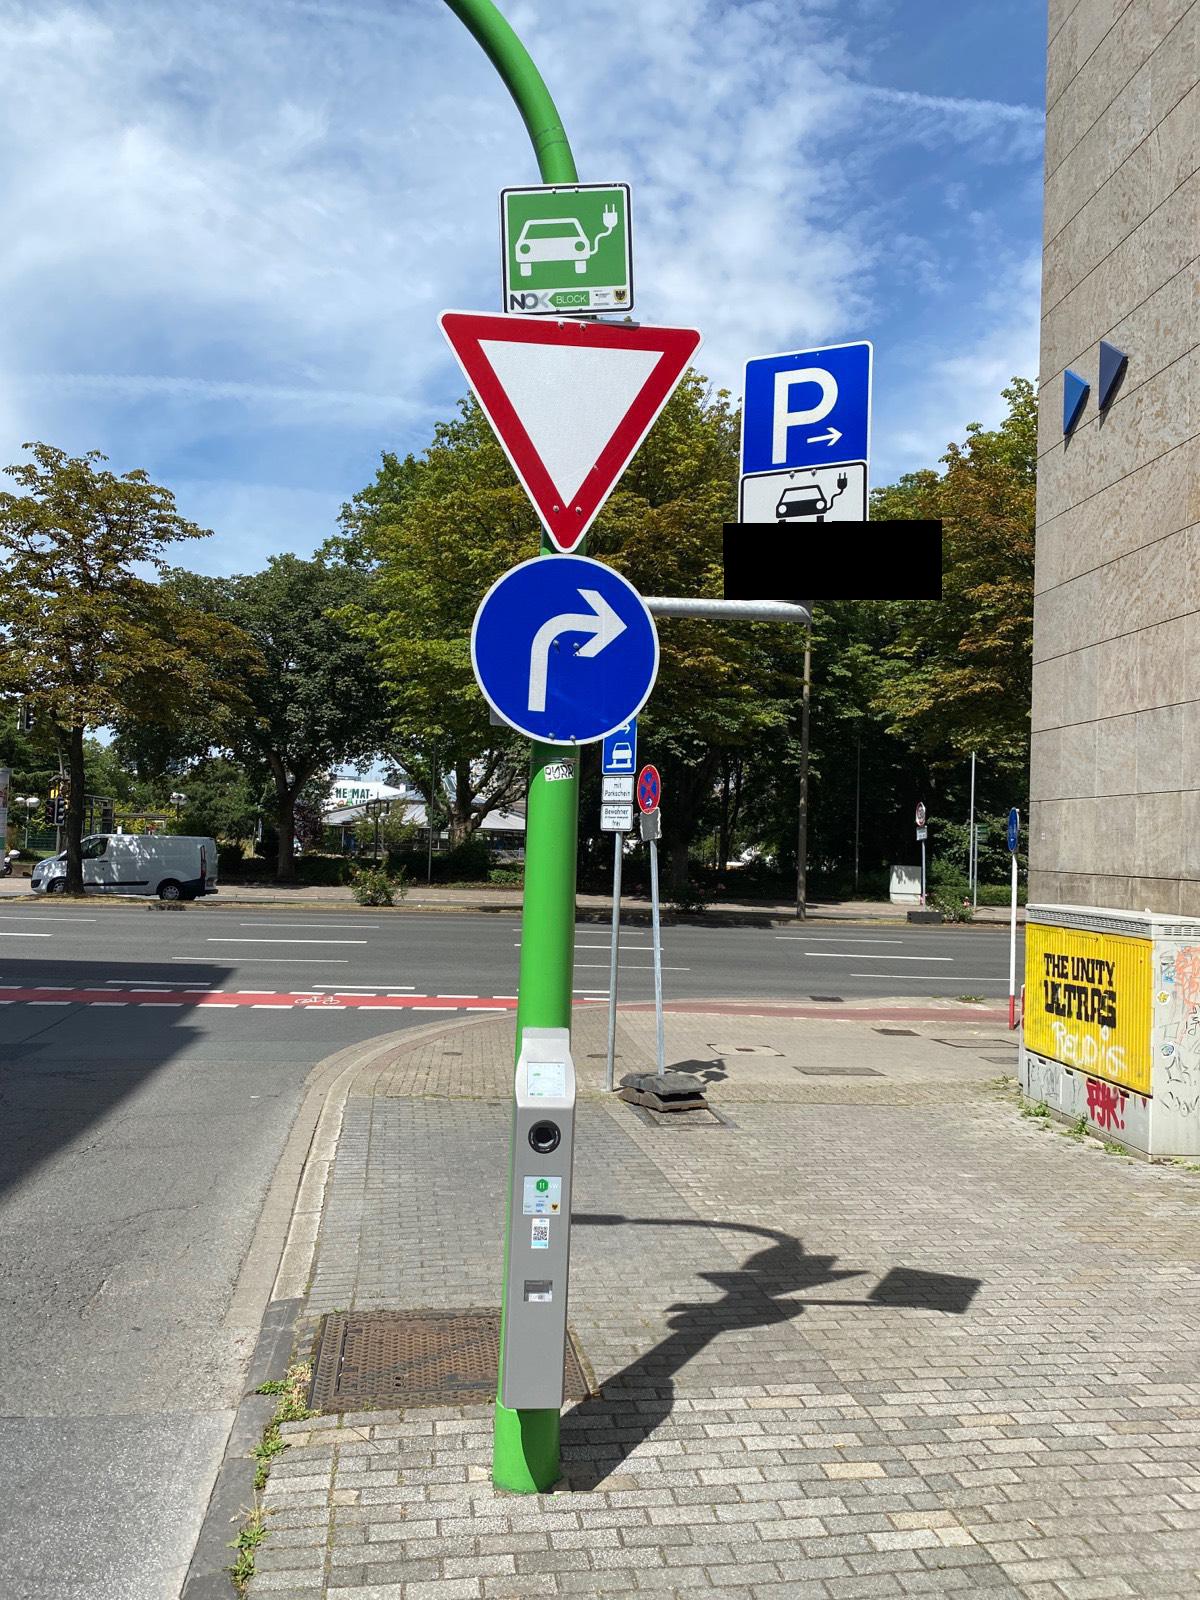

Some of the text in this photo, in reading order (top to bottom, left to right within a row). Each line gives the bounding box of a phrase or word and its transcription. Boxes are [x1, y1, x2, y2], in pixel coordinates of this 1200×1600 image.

[556, 294, 587, 304] BLOCK
[772, 367, 838, 464] P
[604, 789, 630, 797] Parkschein
[604, 807, 629, 815] Bewohner
[1043, 952, 1116, 987] THE UNITY
[1043, 979, 1117, 1029] ULTRAS
